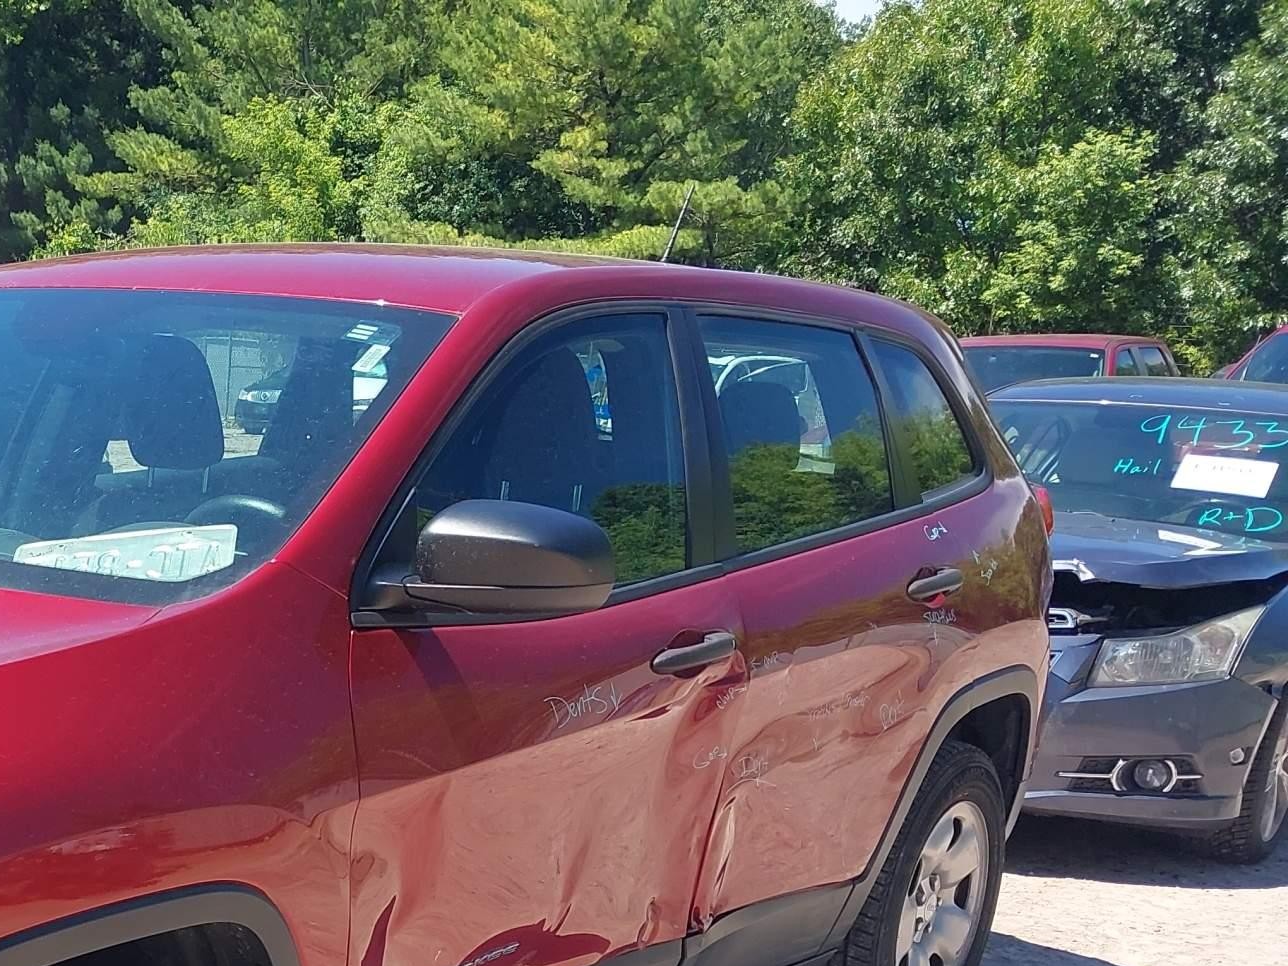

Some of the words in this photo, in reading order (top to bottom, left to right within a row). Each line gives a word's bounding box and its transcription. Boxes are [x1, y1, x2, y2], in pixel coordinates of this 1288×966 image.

[1140, 414, 1288, 449] 9433
[1113, 458, 1162, 475] Hail
[1197, 506, 1283, 532] R+D
